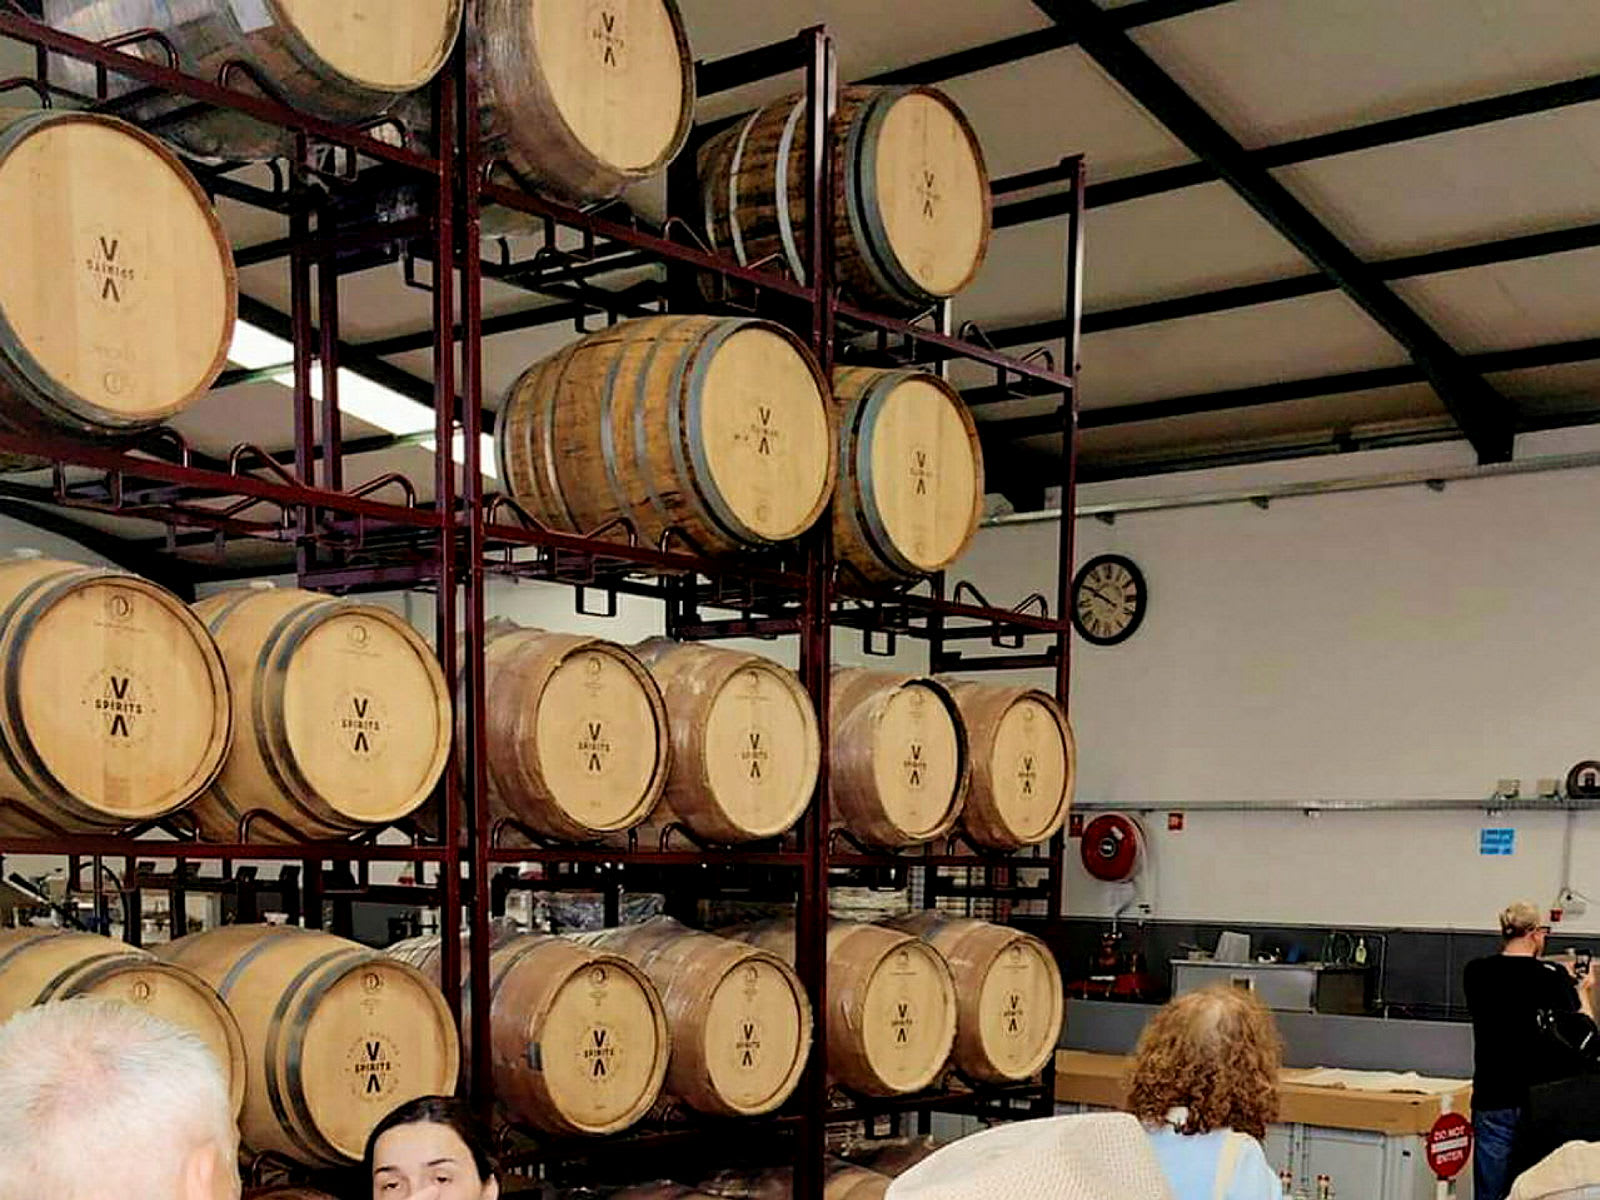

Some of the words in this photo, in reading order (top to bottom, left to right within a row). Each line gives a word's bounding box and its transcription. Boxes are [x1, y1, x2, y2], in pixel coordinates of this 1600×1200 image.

[95, 699, 143, 715] SPIRITS
[354, 1060, 392, 1075] SPIRITS
[1434, 1130, 1447, 1140] DO
[1449, 1125, 1465, 1136] NOT
